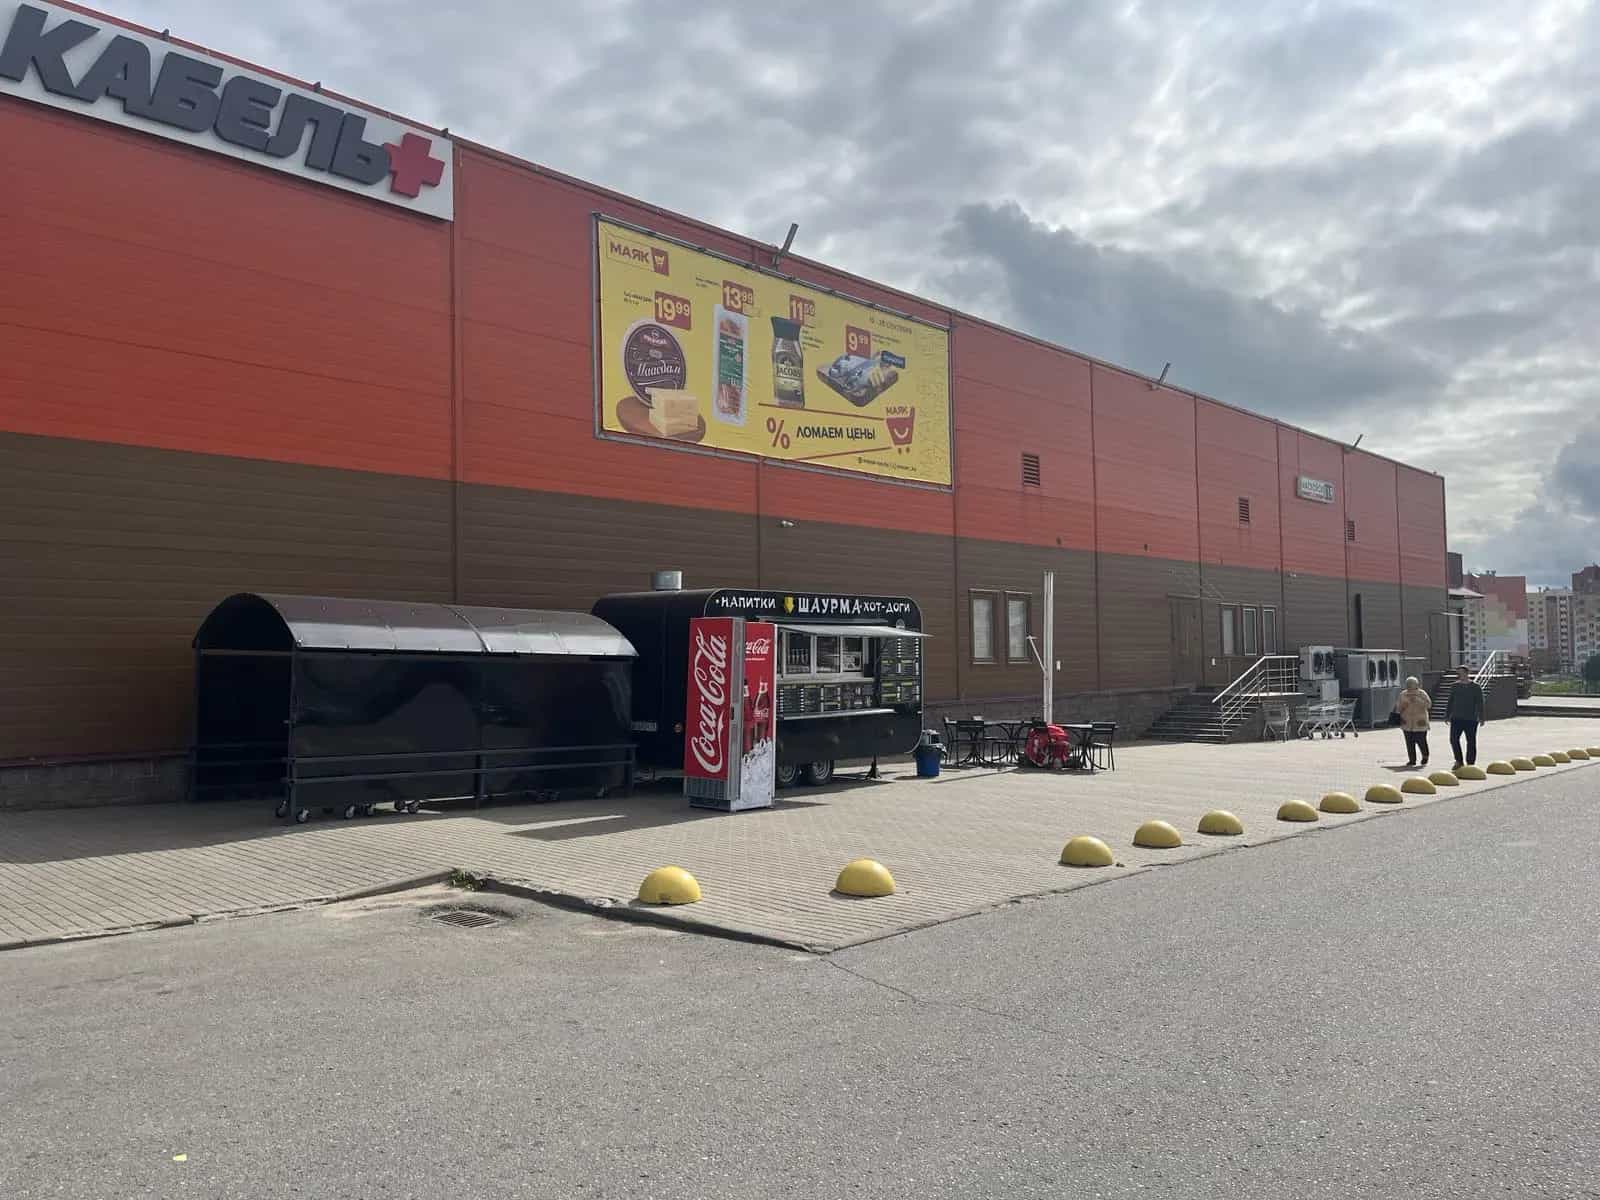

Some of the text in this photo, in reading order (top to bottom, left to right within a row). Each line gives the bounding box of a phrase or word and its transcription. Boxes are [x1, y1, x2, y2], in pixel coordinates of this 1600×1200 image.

[609, 241, 650, 264] МАЯК
[886, 406, 909, 416] МАЯК
[797, 425, 843, 439] ЛОМАЕМ
[846, 428, 876, 441] ЦЕНЫ
[720, 596, 911, 615] НАПИТКИ ШАУРМА ХОТ-ДОГИ
